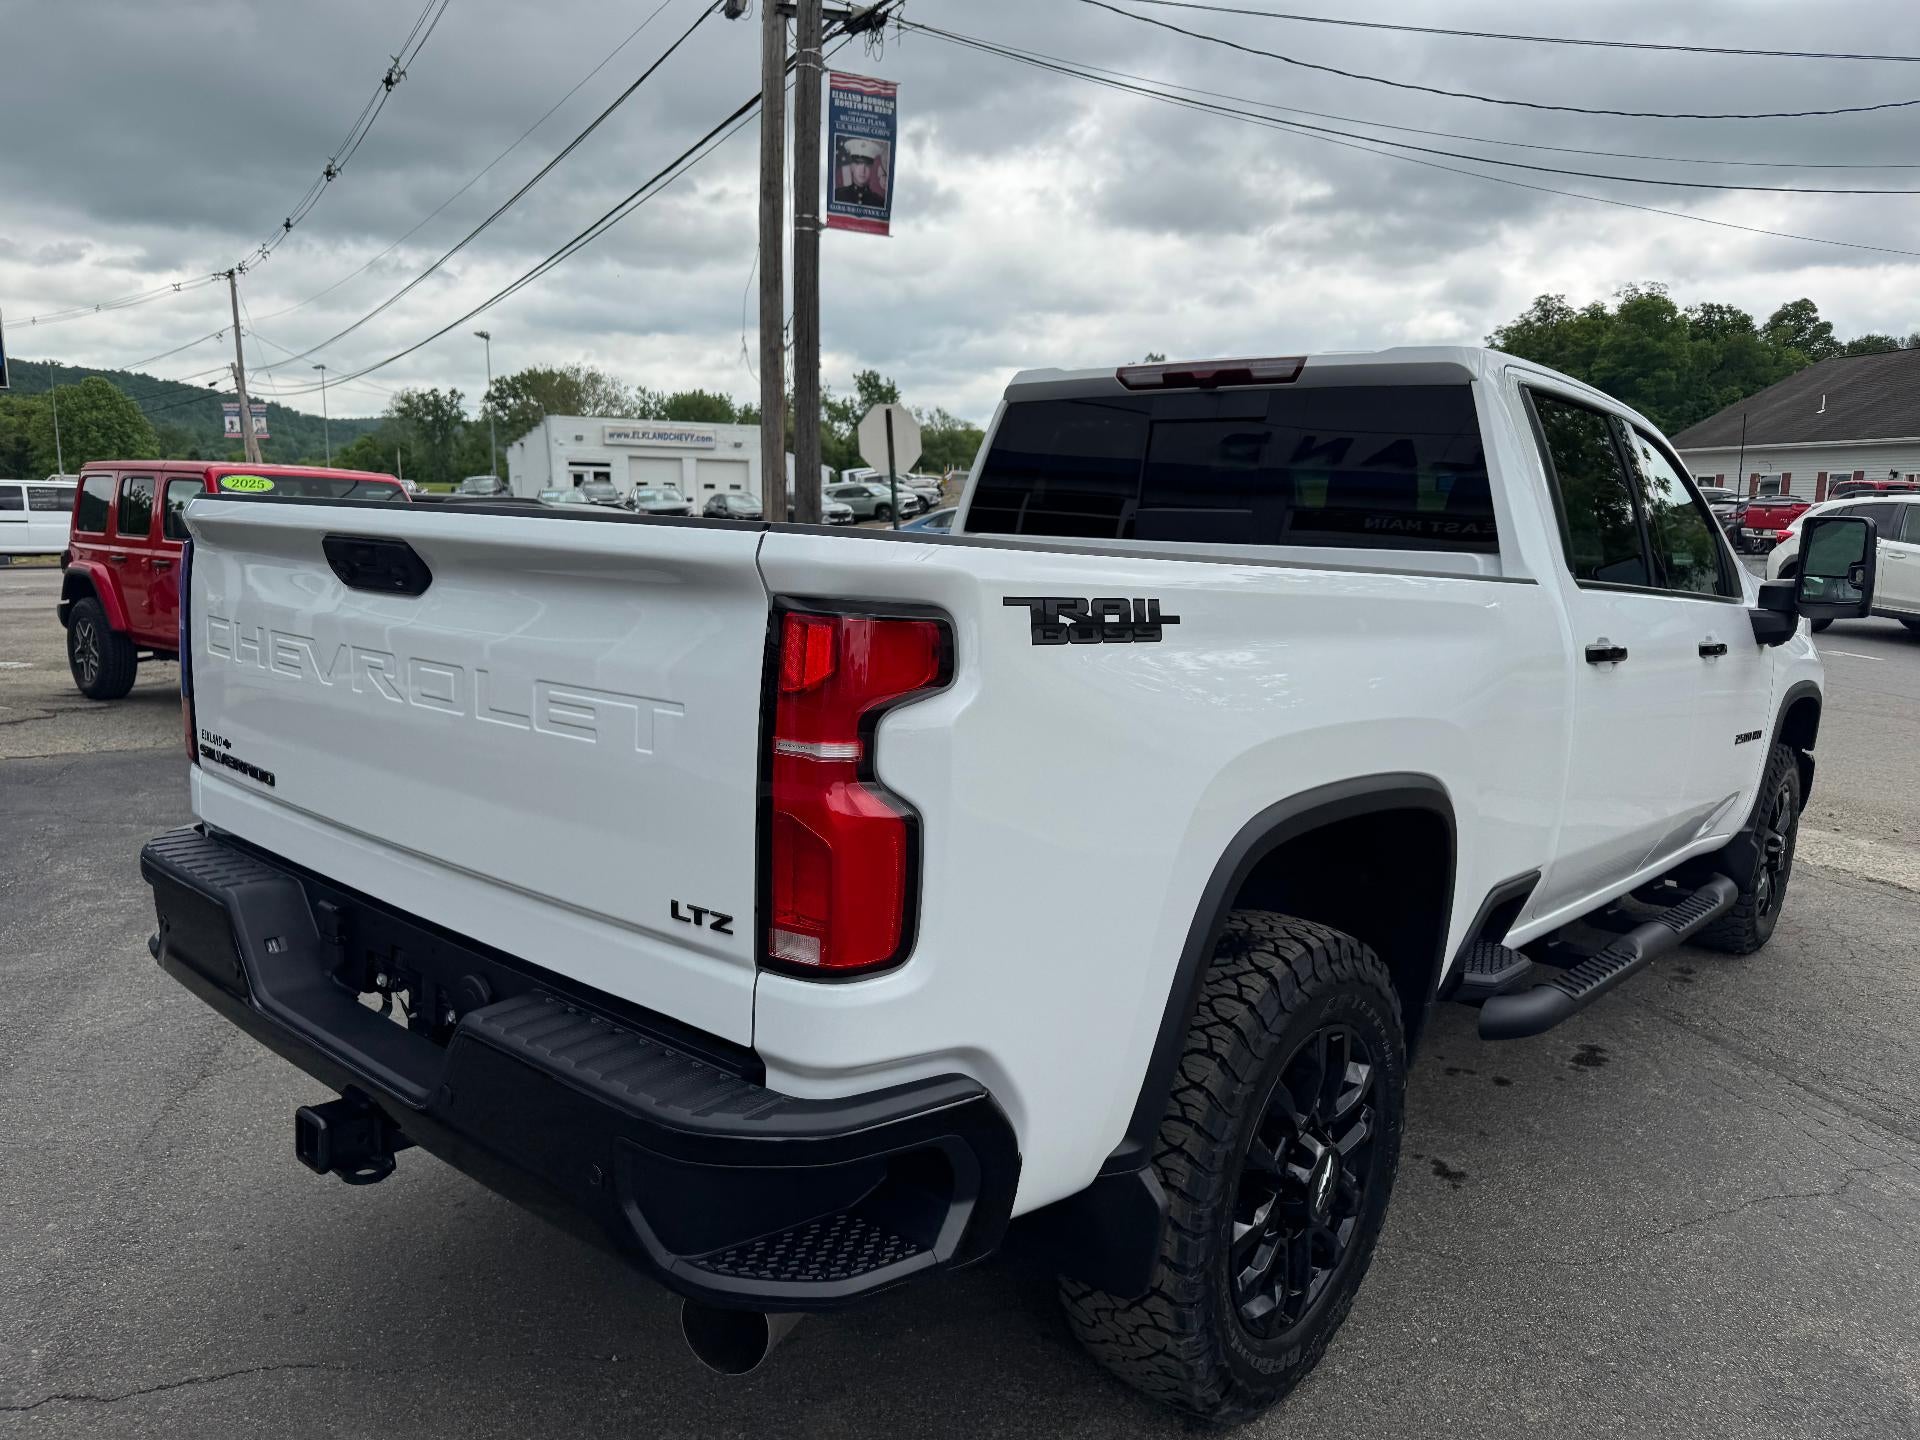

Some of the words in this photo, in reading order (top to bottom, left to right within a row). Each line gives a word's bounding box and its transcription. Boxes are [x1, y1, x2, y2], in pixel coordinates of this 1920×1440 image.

[831, 90, 862, 103] ELKLAND
[834, 98, 873, 112] HOMETOWN
[608, 431, 713, 443] www.ELKLANDCHEVY.com
[231, 478, 265, 489] 2025
[1003, 596, 1180, 624] TRAIL
[1031, 622, 1163, 646] BOSS
[206, 614, 685, 755] CHEVROLET
[199, 743, 276, 787] SILVERADO
[670, 898, 734, 935] LTZ
